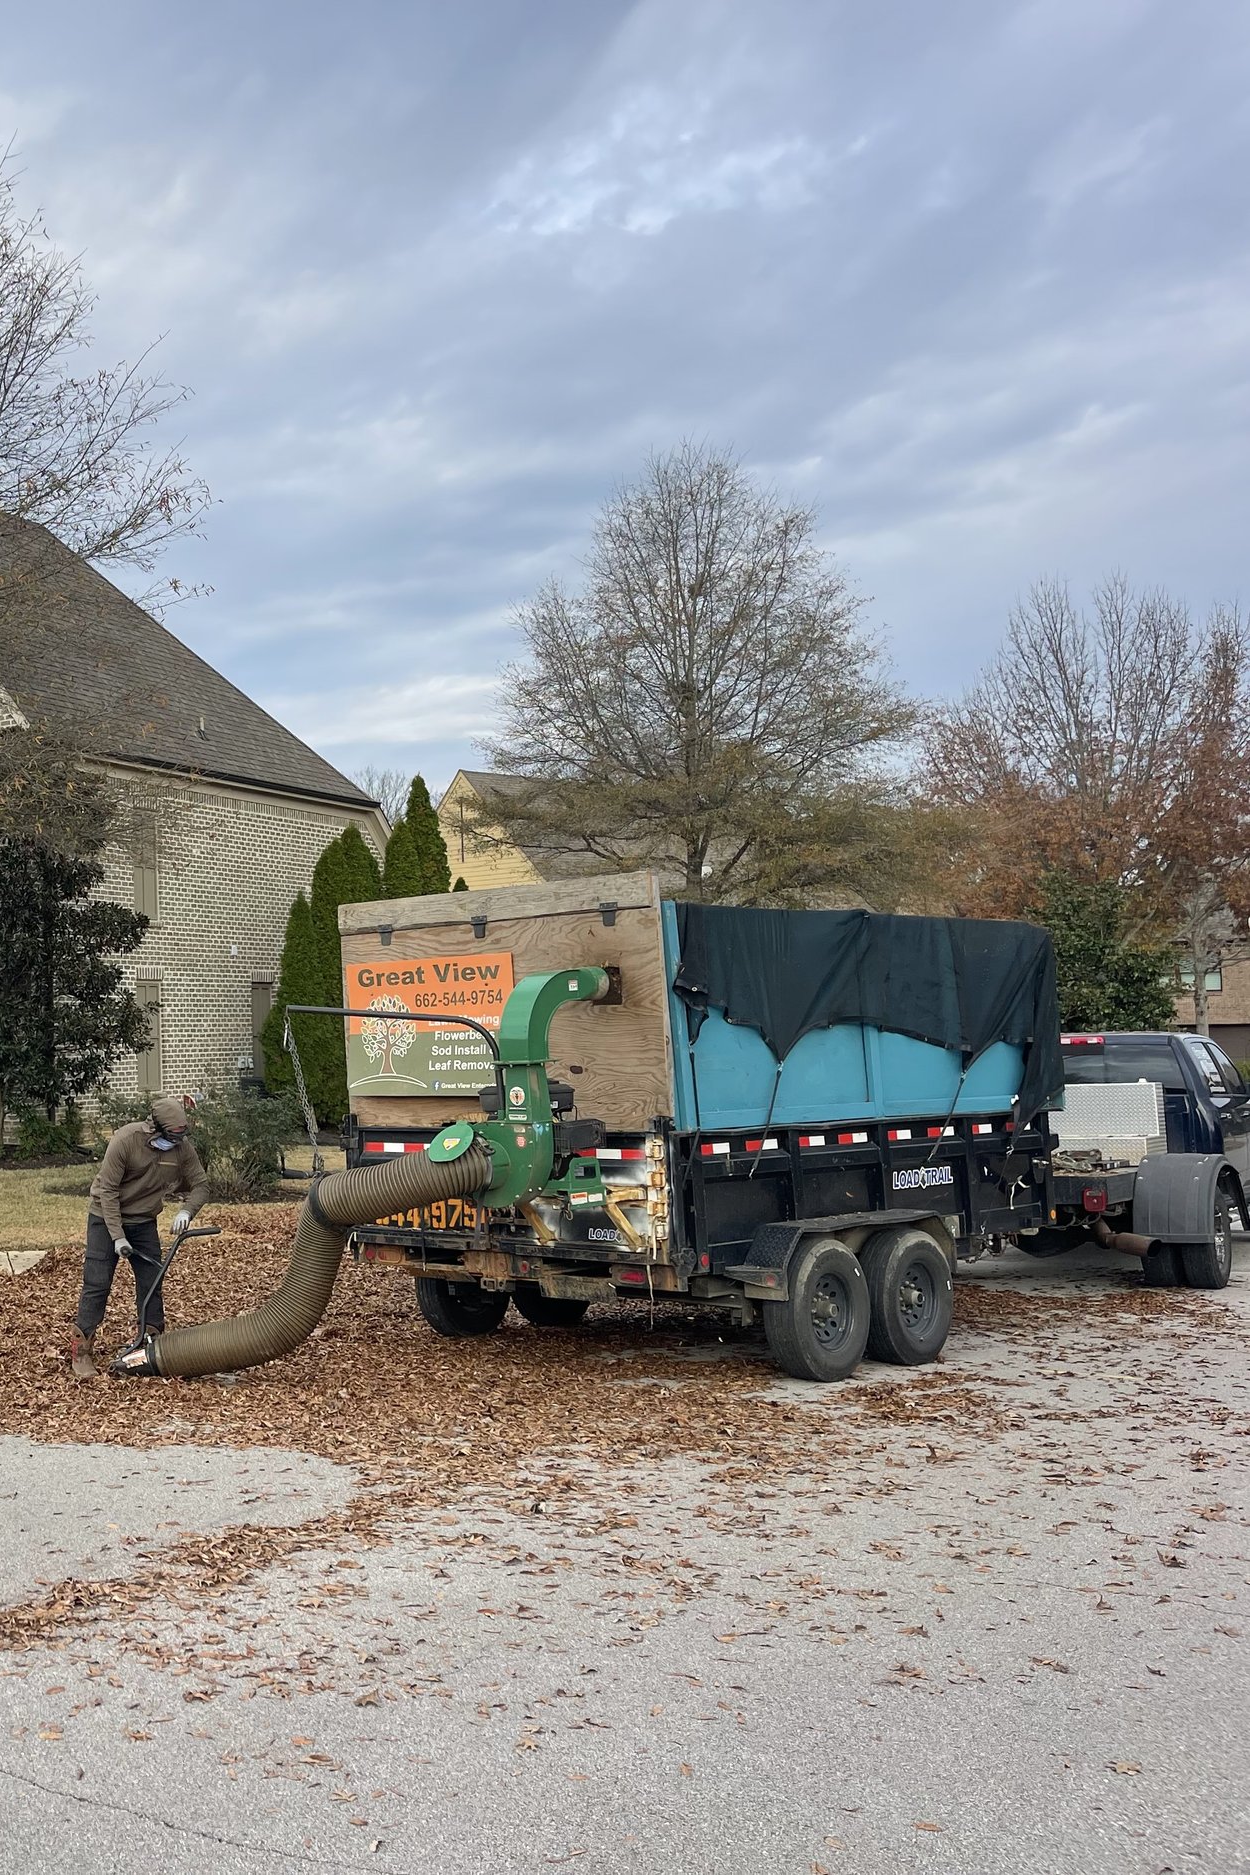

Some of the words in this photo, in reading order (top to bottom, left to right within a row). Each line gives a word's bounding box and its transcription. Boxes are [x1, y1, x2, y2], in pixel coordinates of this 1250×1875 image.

[357, 966, 426, 988] Great
[432, 962, 500, 983] View
[415, 988, 503, 1008] 662-544-9754
[431, 1045, 452, 1056] Sod
[454, 1044, 487, 1055] Install
[428, 1060, 451, 1071] Leaf
[893, 1169, 920, 1190] LOAD
[925, 1166, 954, 1186] TRAIL
[588, 1228, 617, 1240] LOAD
